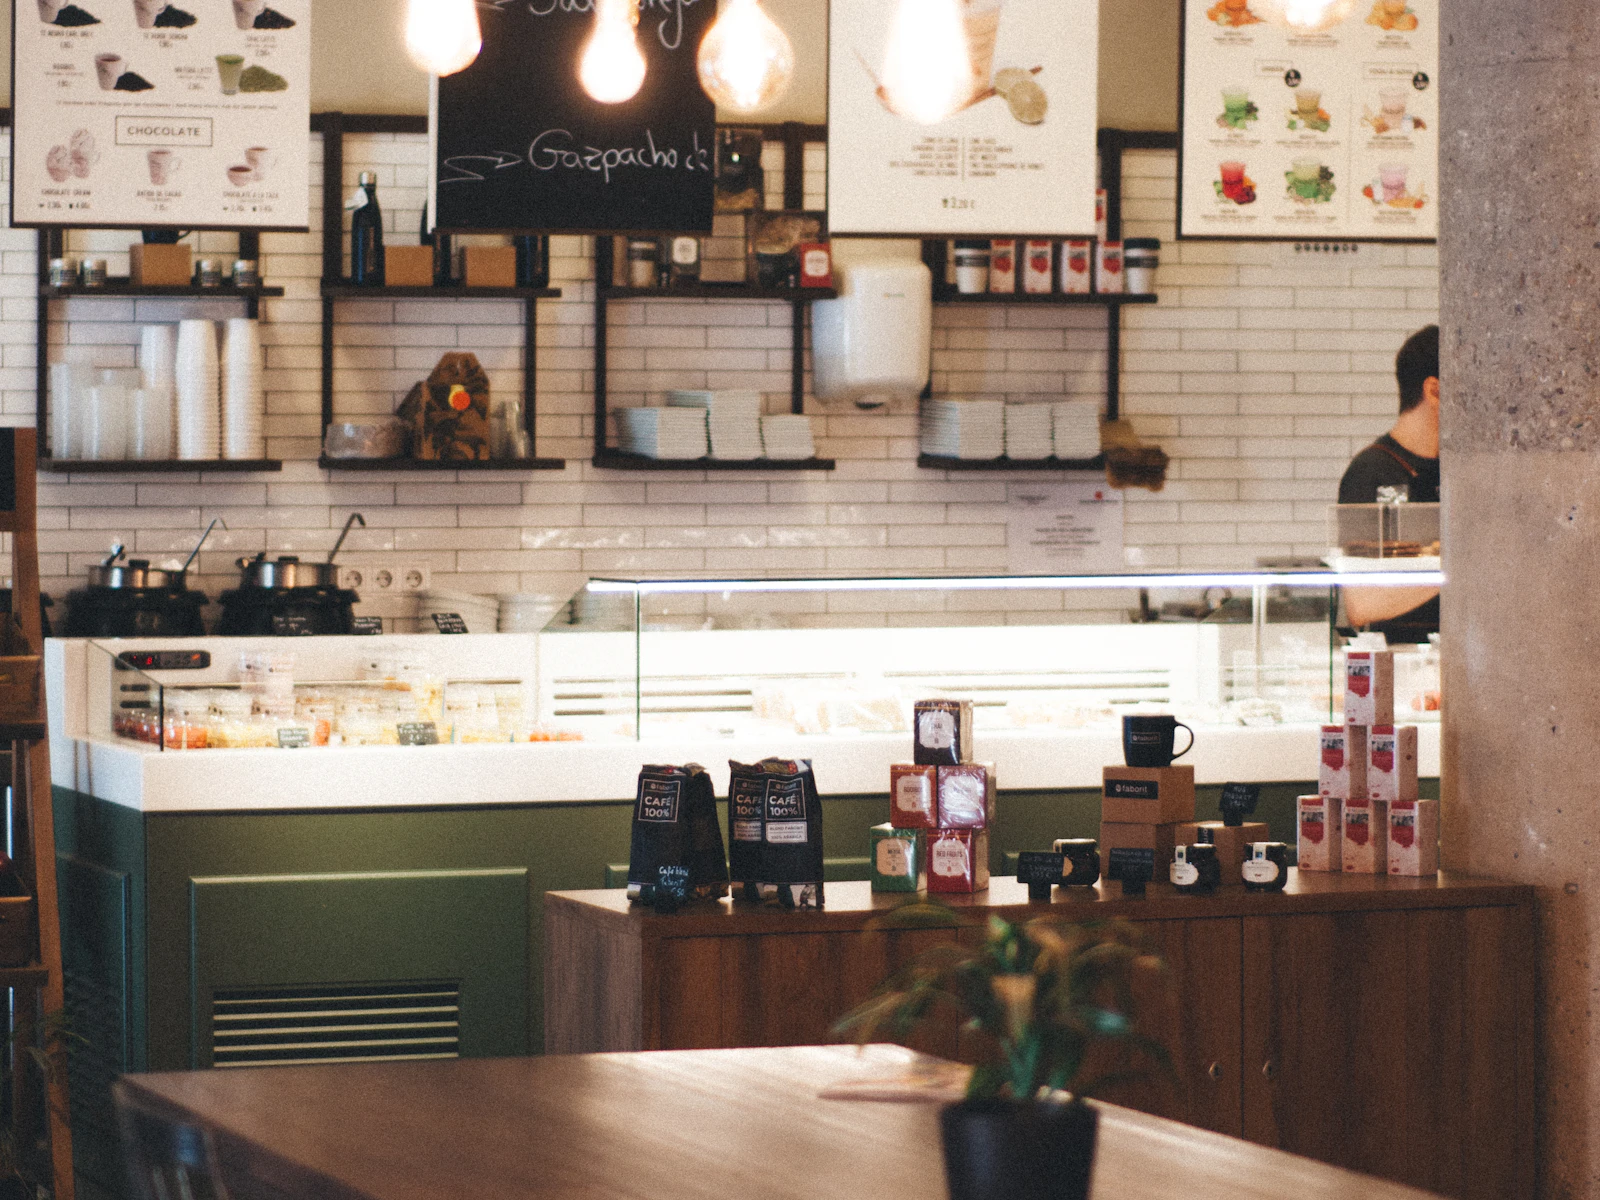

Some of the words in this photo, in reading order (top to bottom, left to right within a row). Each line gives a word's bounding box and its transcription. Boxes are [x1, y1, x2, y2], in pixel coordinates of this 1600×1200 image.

[127, 126, 200, 136] CHOCOLATE
[528, 128, 678, 184] Gazpacho
[1122, 784, 1148, 793] faborit
[644, 796, 671, 807] CAFÉ
[769, 793, 796, 805] CAFÉ
[644, 808, 670, 818] 100%
[770, 807, 798, 816] 100%
[947, 850, 963, 858] FRUITS
